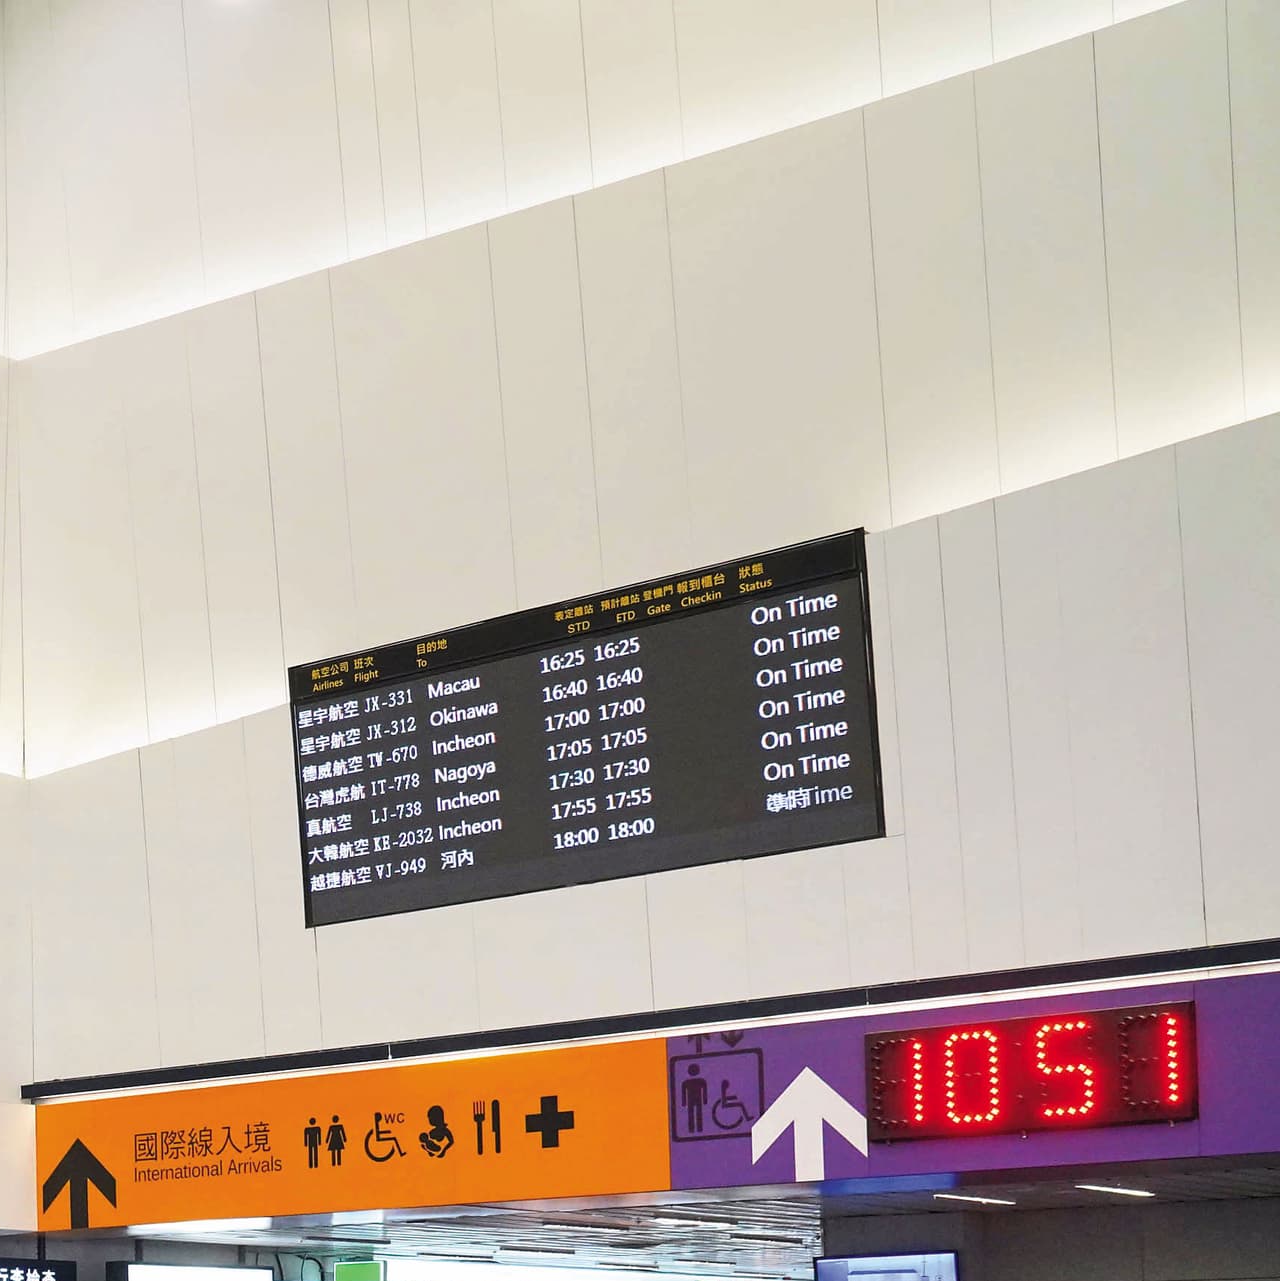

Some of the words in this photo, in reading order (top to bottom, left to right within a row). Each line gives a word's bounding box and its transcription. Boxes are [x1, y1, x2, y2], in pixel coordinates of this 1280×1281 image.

[298, 701, 359, 728] 星宇航空
[364, 689, 413, 713] JX-331
[428, 677, 480, 699] Macau
[540, 649, 585, 674] 16:25
[593, 637, 640, 662] 16:25
[751, 606, 782, 625] On
[786, 592, 838, 617] Time
[300, 729, 361, 756] 星宇航空
[366, 717, 417, 741] JX-312
[430, 702, 498, 727] Okinawa
[542, 679, 588, 703] 16:40
[596, 667, 643, 692] 16:40
[754, 637, 784, 656] On
[789, 624, 841, 649] Time
[312, 662, 349, 680] 航空公司
[354, 656, 375, 670] 班次
[416, 639, 448, 655] 目的地
[313, 678, 344, 692] Airlines
[354, 669, 379, 683] Flight
[416, 659, 427, 668] To
[567, 620, 590, 634] STD
[616, 611, 636, 624] ETD
[647, 602, 671, 617] Gate
[681, 591, 722, 608] Checkin
[739, 577, 773, 594] Status
[302, 757, 363, 783] 德威航空
[367, 745, 418, 768] TW-670
[432, 732, 496, 755] Incheon
[544, 708, 590, 733] 17:00
[598, 697, 645, 721] 17:00
[756, 668, 787, 687] On
[791, 656, 843, 680] Time
[305, 783, 366, 809] 台灣虎航
[371, 773, 420, 796] IT-778
[434, 761, 496, 785] Nagoya
[547, 738, 592, 762] 17:05
[601, 727, 647, 751] 17:05
[759, 700, 789, 719] On
[793, 688, 845, 712] Time
[306, 814, 352, 838] 真航空
[371, 801, 422, 824] LJ-738
[437, 789, 500, 812] Incheon
[549, 767, 595, 791] 17:30
[603, 757, 650, 781] 17:30
[761, 731, 792, 750] On
[796, 720, 848, 744] Time
[308, 839, 370, 865] 大韓航空
[373, 828, 433, 853] KE-2032
[438, 817, 502, 841] Incheon
[552, 797, 596, 821] 17:55
[605, 787, 652, 811] 17:55
[764, 763, 794, 781] On
[798, 753, 850, 776] Time
[310, 866, 372, 893] 越捷航空
[376, 857, 426, 880] VJ-949
[554, 827, 599, 850] 18:00
[608, 818, 655, 841] 18:00
[133, 1122, 272, 1164] 國際線入境
[133, 1160, 223, 1183] International
[227, 1155, 283, 1176] Arrivals
[384, 1112, 406, 1125] WC
